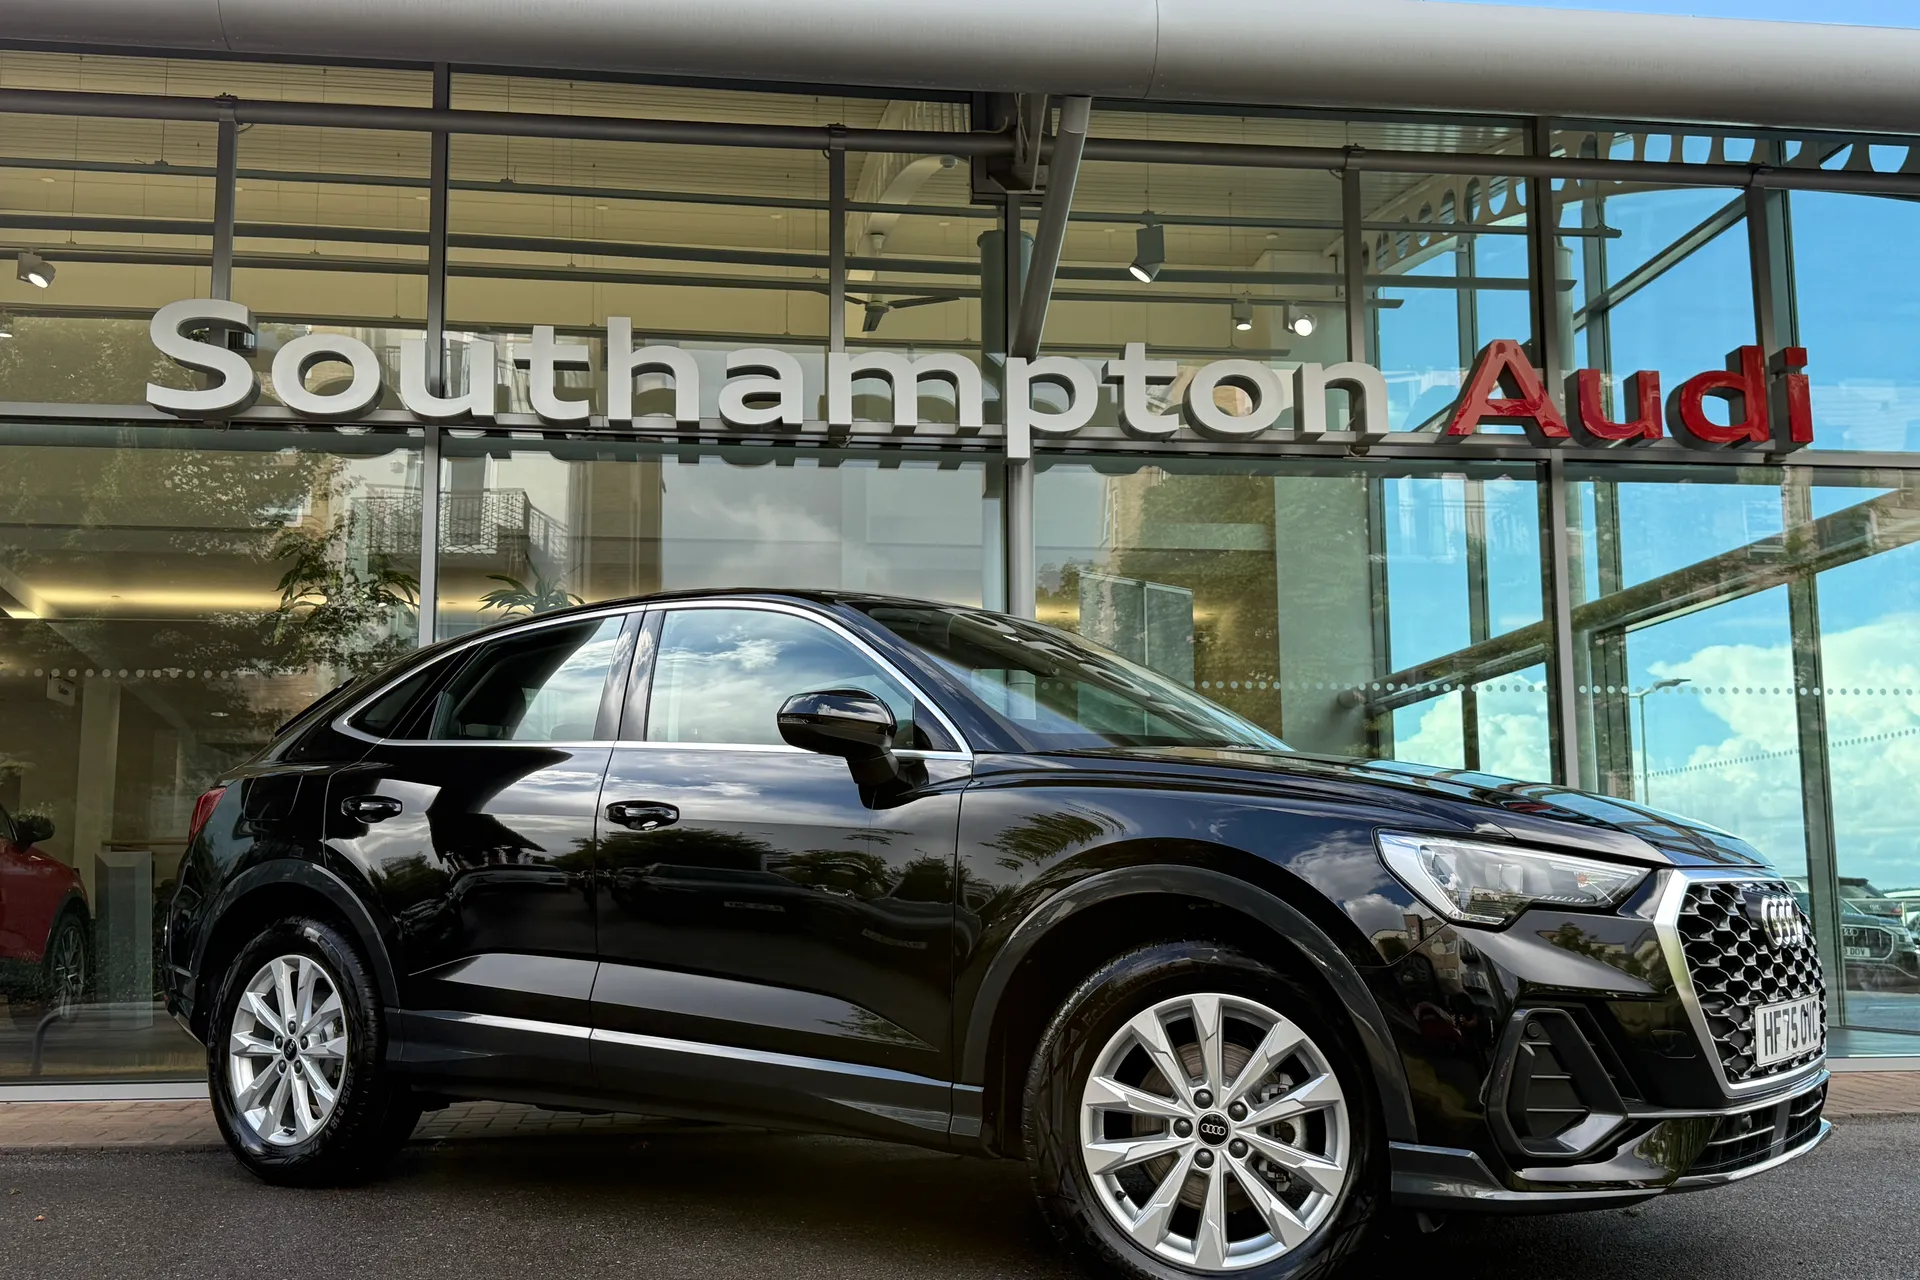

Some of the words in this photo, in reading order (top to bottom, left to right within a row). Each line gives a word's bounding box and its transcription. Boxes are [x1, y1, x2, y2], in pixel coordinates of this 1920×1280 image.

[146, 298, 1390, 463] Southampton
[1439, 338, 1814, 452] Audi
[1764, 1006, 1798, 1057] HF75
[1800, 1000, 1818, 1046] OYC
